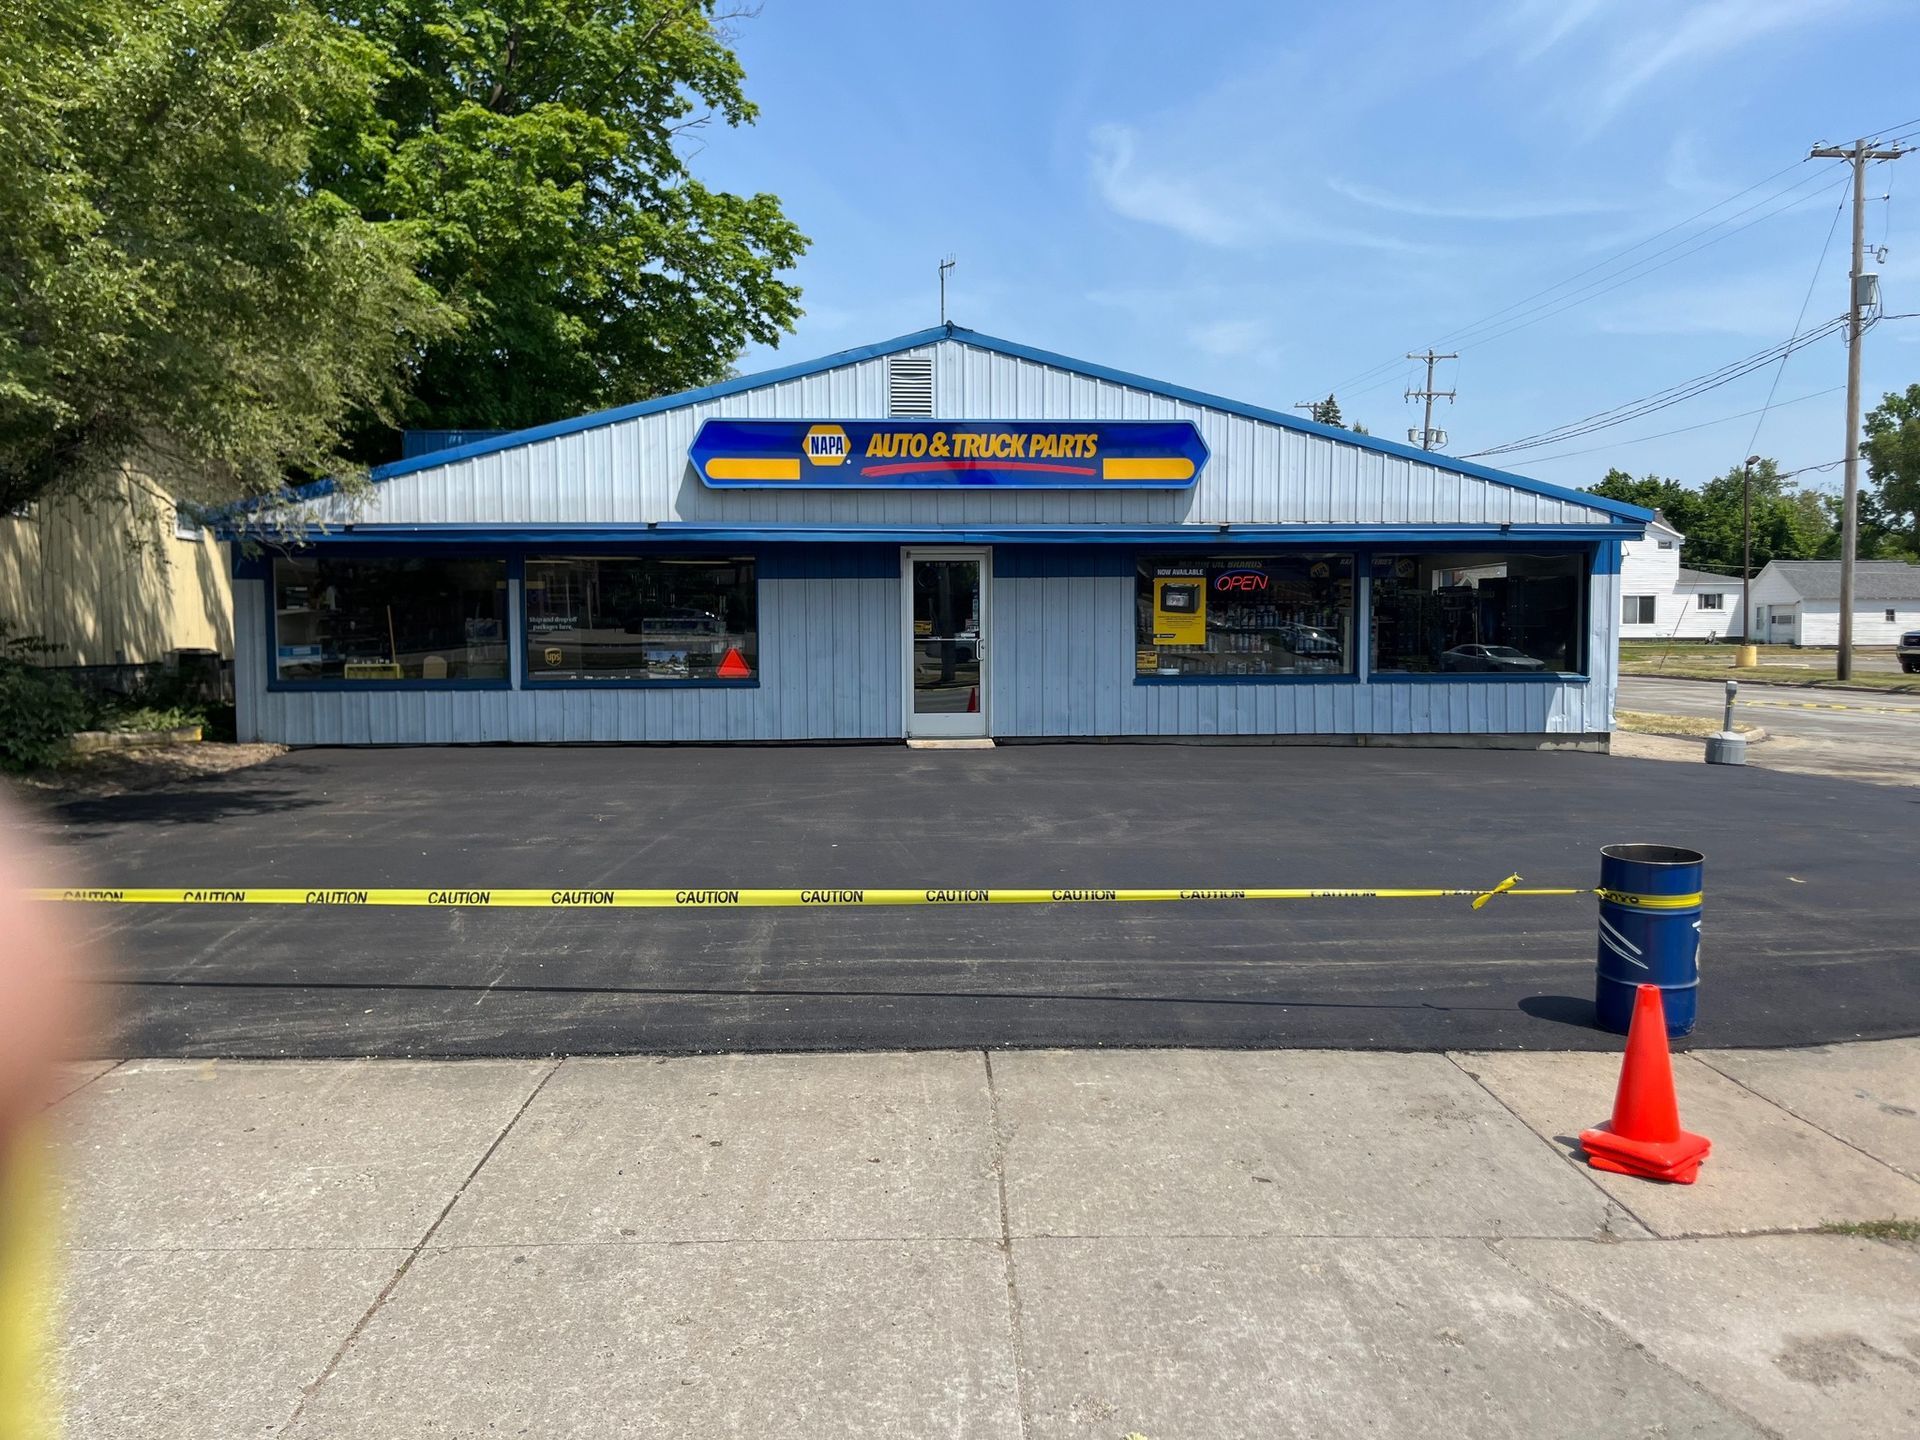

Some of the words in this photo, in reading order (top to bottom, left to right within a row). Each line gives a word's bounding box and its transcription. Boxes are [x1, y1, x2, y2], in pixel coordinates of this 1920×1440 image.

[811, 436, 844, 455] NAPA
[866, 433, 928, 458] AUTO
[929, 432, 950, 458] &
[952, 434, 1028, 458] TRUCK
[1029, 434, 1098, 458] PARTS
[1217, 575, 1268, 592] OPEN
[546, 653, 561, 664] ups
[183, 891, 245, 902] CAUTION
[305, 891, 368, 904] CAUTION
[427, 891, 490, 904] CAUTION
[551, 891, 614, 904] CAUTION
[675, 891, 739, 904] CAUTION
[800, 890, 864, 903] CAUTION
[926, 890, 989, 902] CAUTION
[1052, 890, 1116, 901] CAUTION
[1180, 890, 1246, 900] CAUTION
